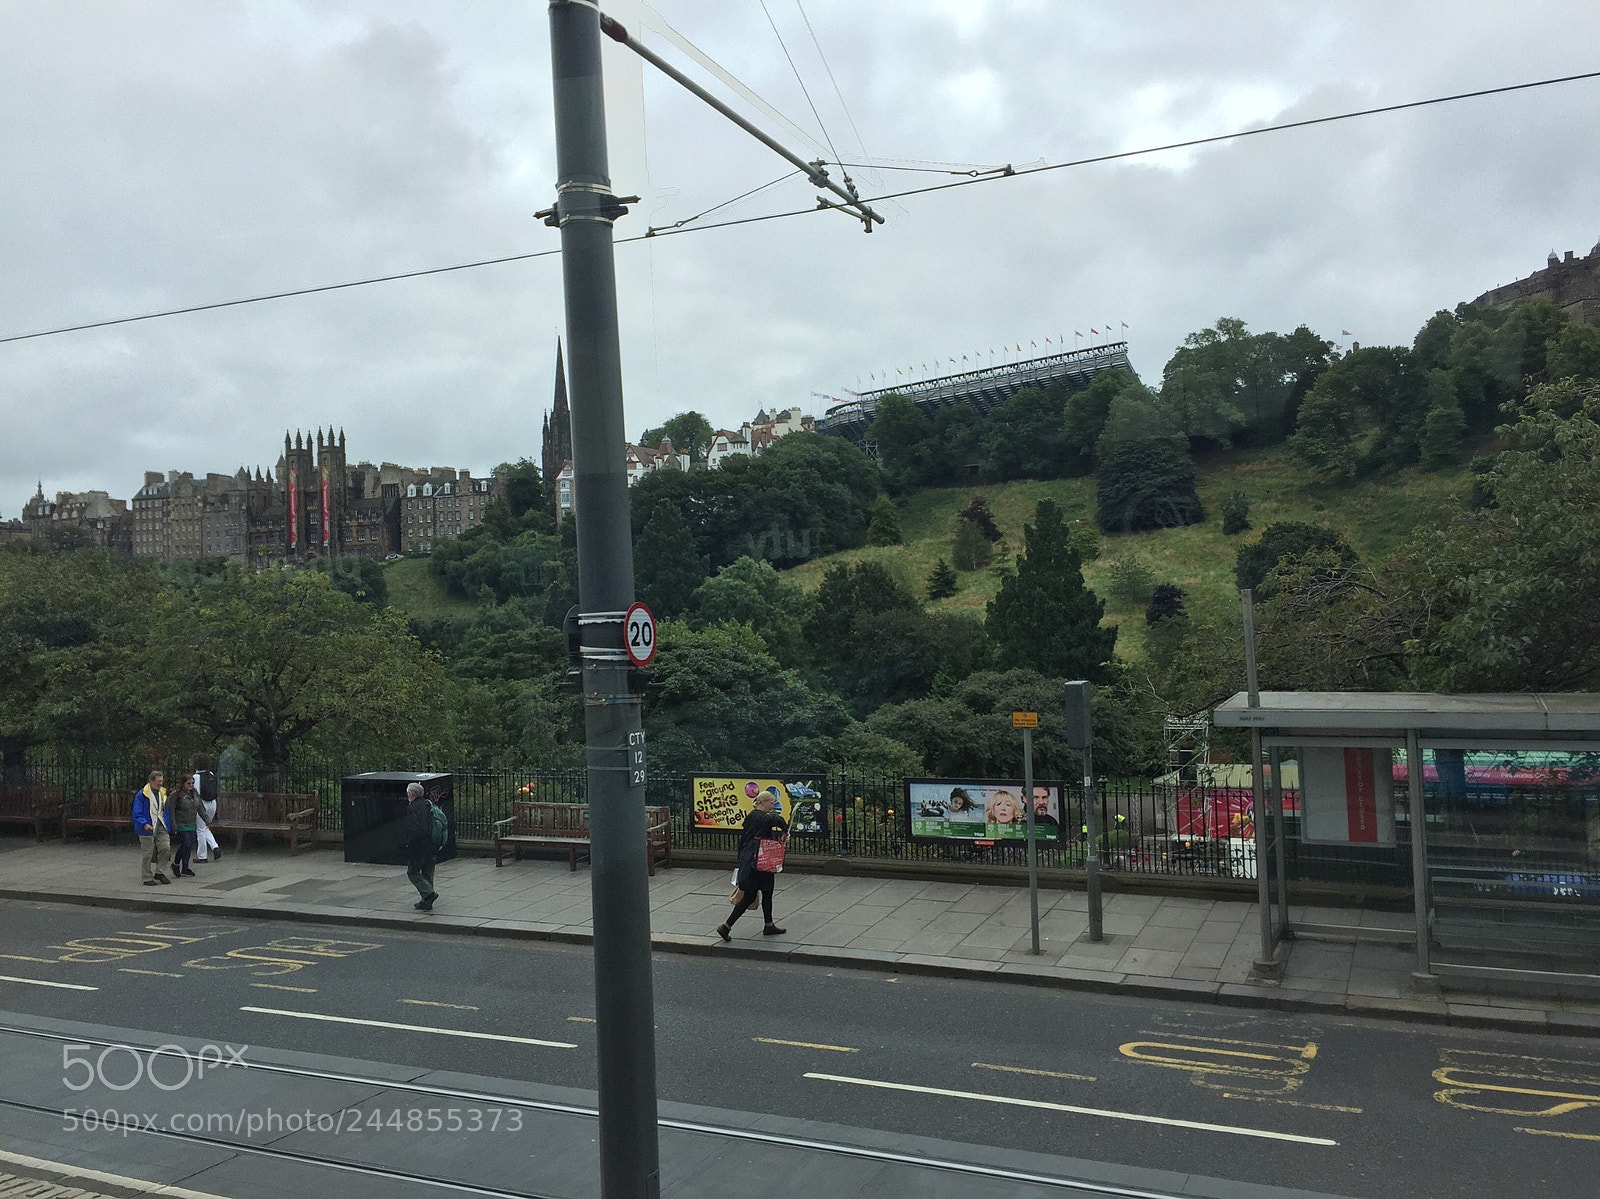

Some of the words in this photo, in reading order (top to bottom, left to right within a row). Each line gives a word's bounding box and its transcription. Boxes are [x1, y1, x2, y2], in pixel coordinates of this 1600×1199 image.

[630, 621, 652, 647] 20
[629, 731, 646, 746] CTY
[634, 750, 643, 764] 12
[634, 770, 645, 784] 29
[699, 780, 715, 789] Feel
[706, 781, 735, 798] ground
[704, 808, 735, 820] beneath
[182, 936, 385, 977] BUS
